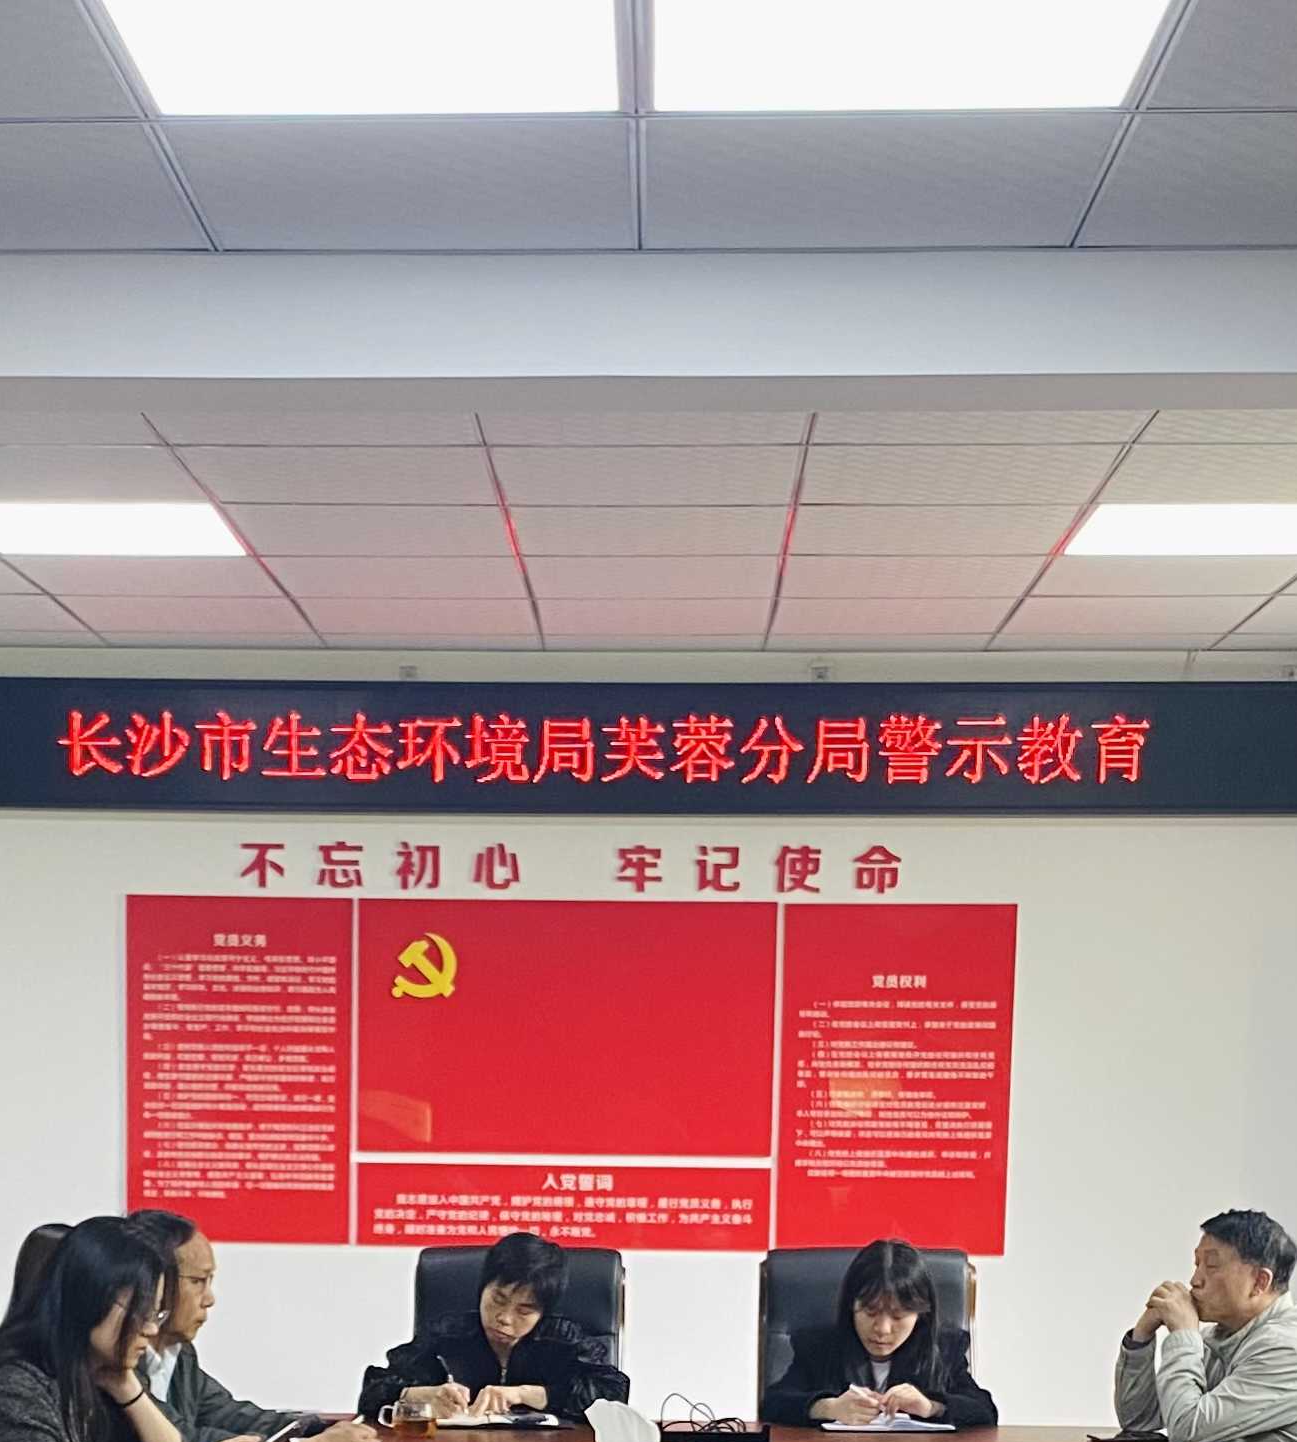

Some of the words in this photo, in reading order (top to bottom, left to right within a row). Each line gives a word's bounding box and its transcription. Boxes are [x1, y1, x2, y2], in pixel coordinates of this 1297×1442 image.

[57, 710, 1152, 785] 长沙市生态环境局芙蓉分局警示教育
[240, 842, 522, 891] 不忘初心
[616, 844, 903, 894] 牢记使命
